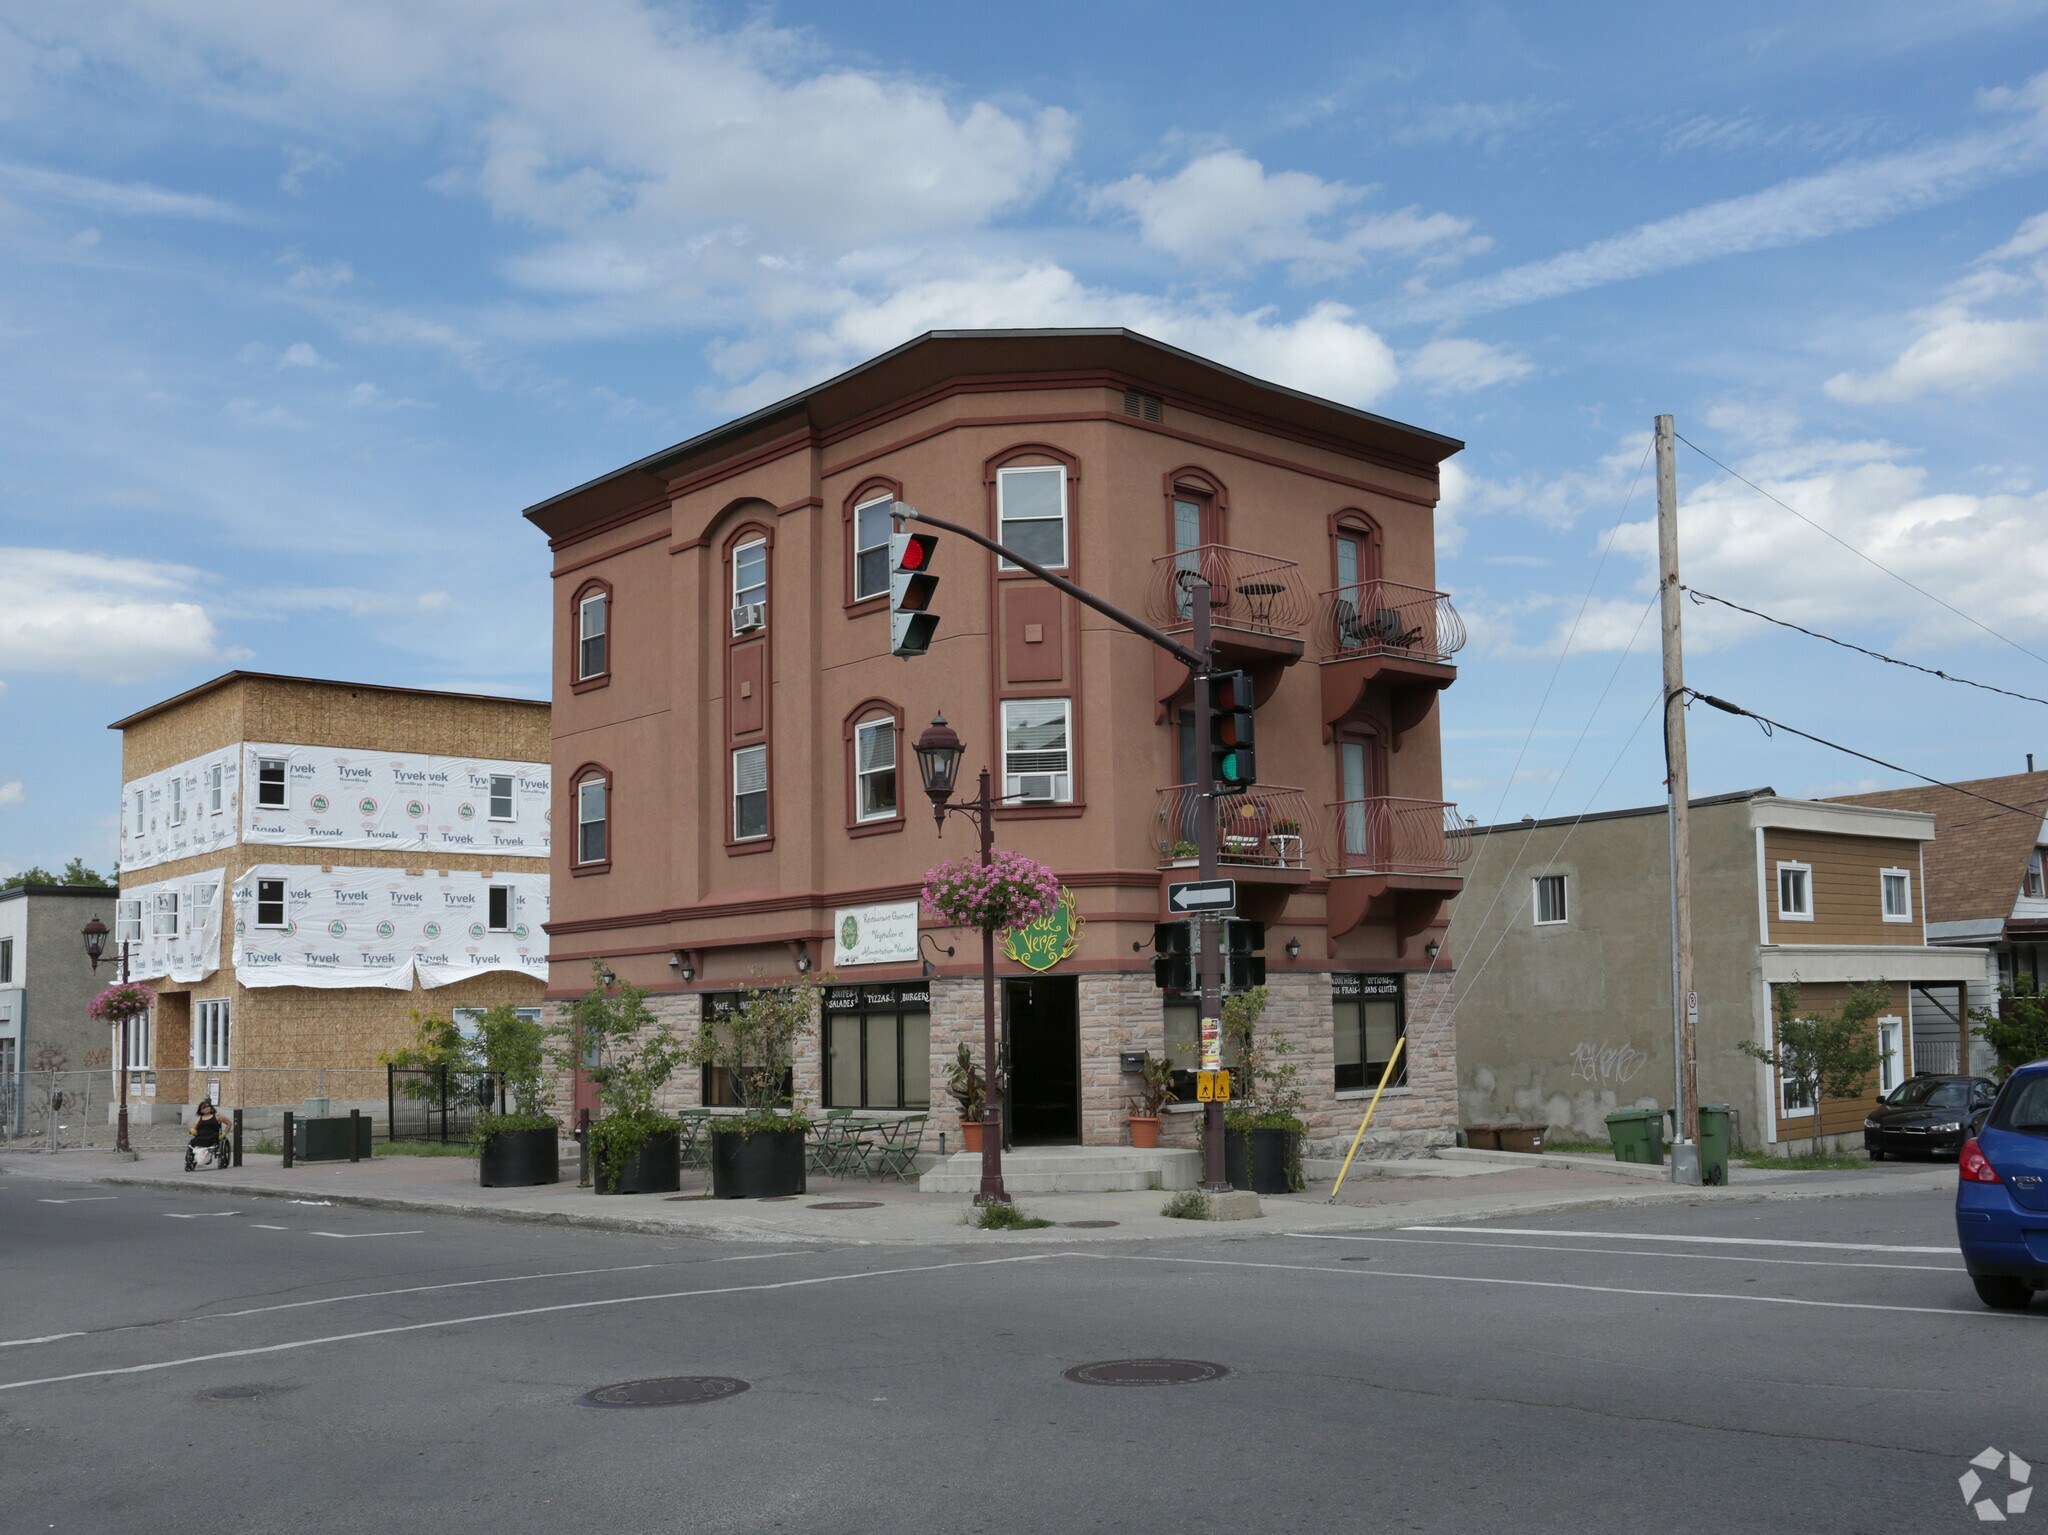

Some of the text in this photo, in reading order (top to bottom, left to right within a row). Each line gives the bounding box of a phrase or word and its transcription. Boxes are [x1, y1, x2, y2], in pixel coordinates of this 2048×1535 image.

[290, 764, 315, 774] yvek
[338, 766, 372, 777] Tyvek
[394, 770, 426, 781] Tyvek
[429, 772, 448, 782] vek
[519, 778, 549, 789] Tyvek
[442, 833, 474, 844] Tyvek
[493, 836, 524, 846] Tyvek
[291, 889, 312, 898] vek
[334, 890, 368, 900] Tyvek
[390, 892, 422, 902] Tyvek
[443, 893, 475, 903] Tyvek
[863, 914, 891, 924] Restaurant
[891, 911, 914, 920] Gourmet
[1020, 930, 1057, 953] Verte
[862, 944, 914, 956] Alimentation Vivante
[246, 952, 282, 964] Tyvek
[305, 953, 340, 964] Tyvek
[362, 953, 395, 964] Tyvek
[469, 954, 500, 963] Tyvek
[867, 994, 890, 1003] PIZZAS
[902, 992, 930, 1002] BURGERS
[829, 1000, 854, 1008] SALADES
